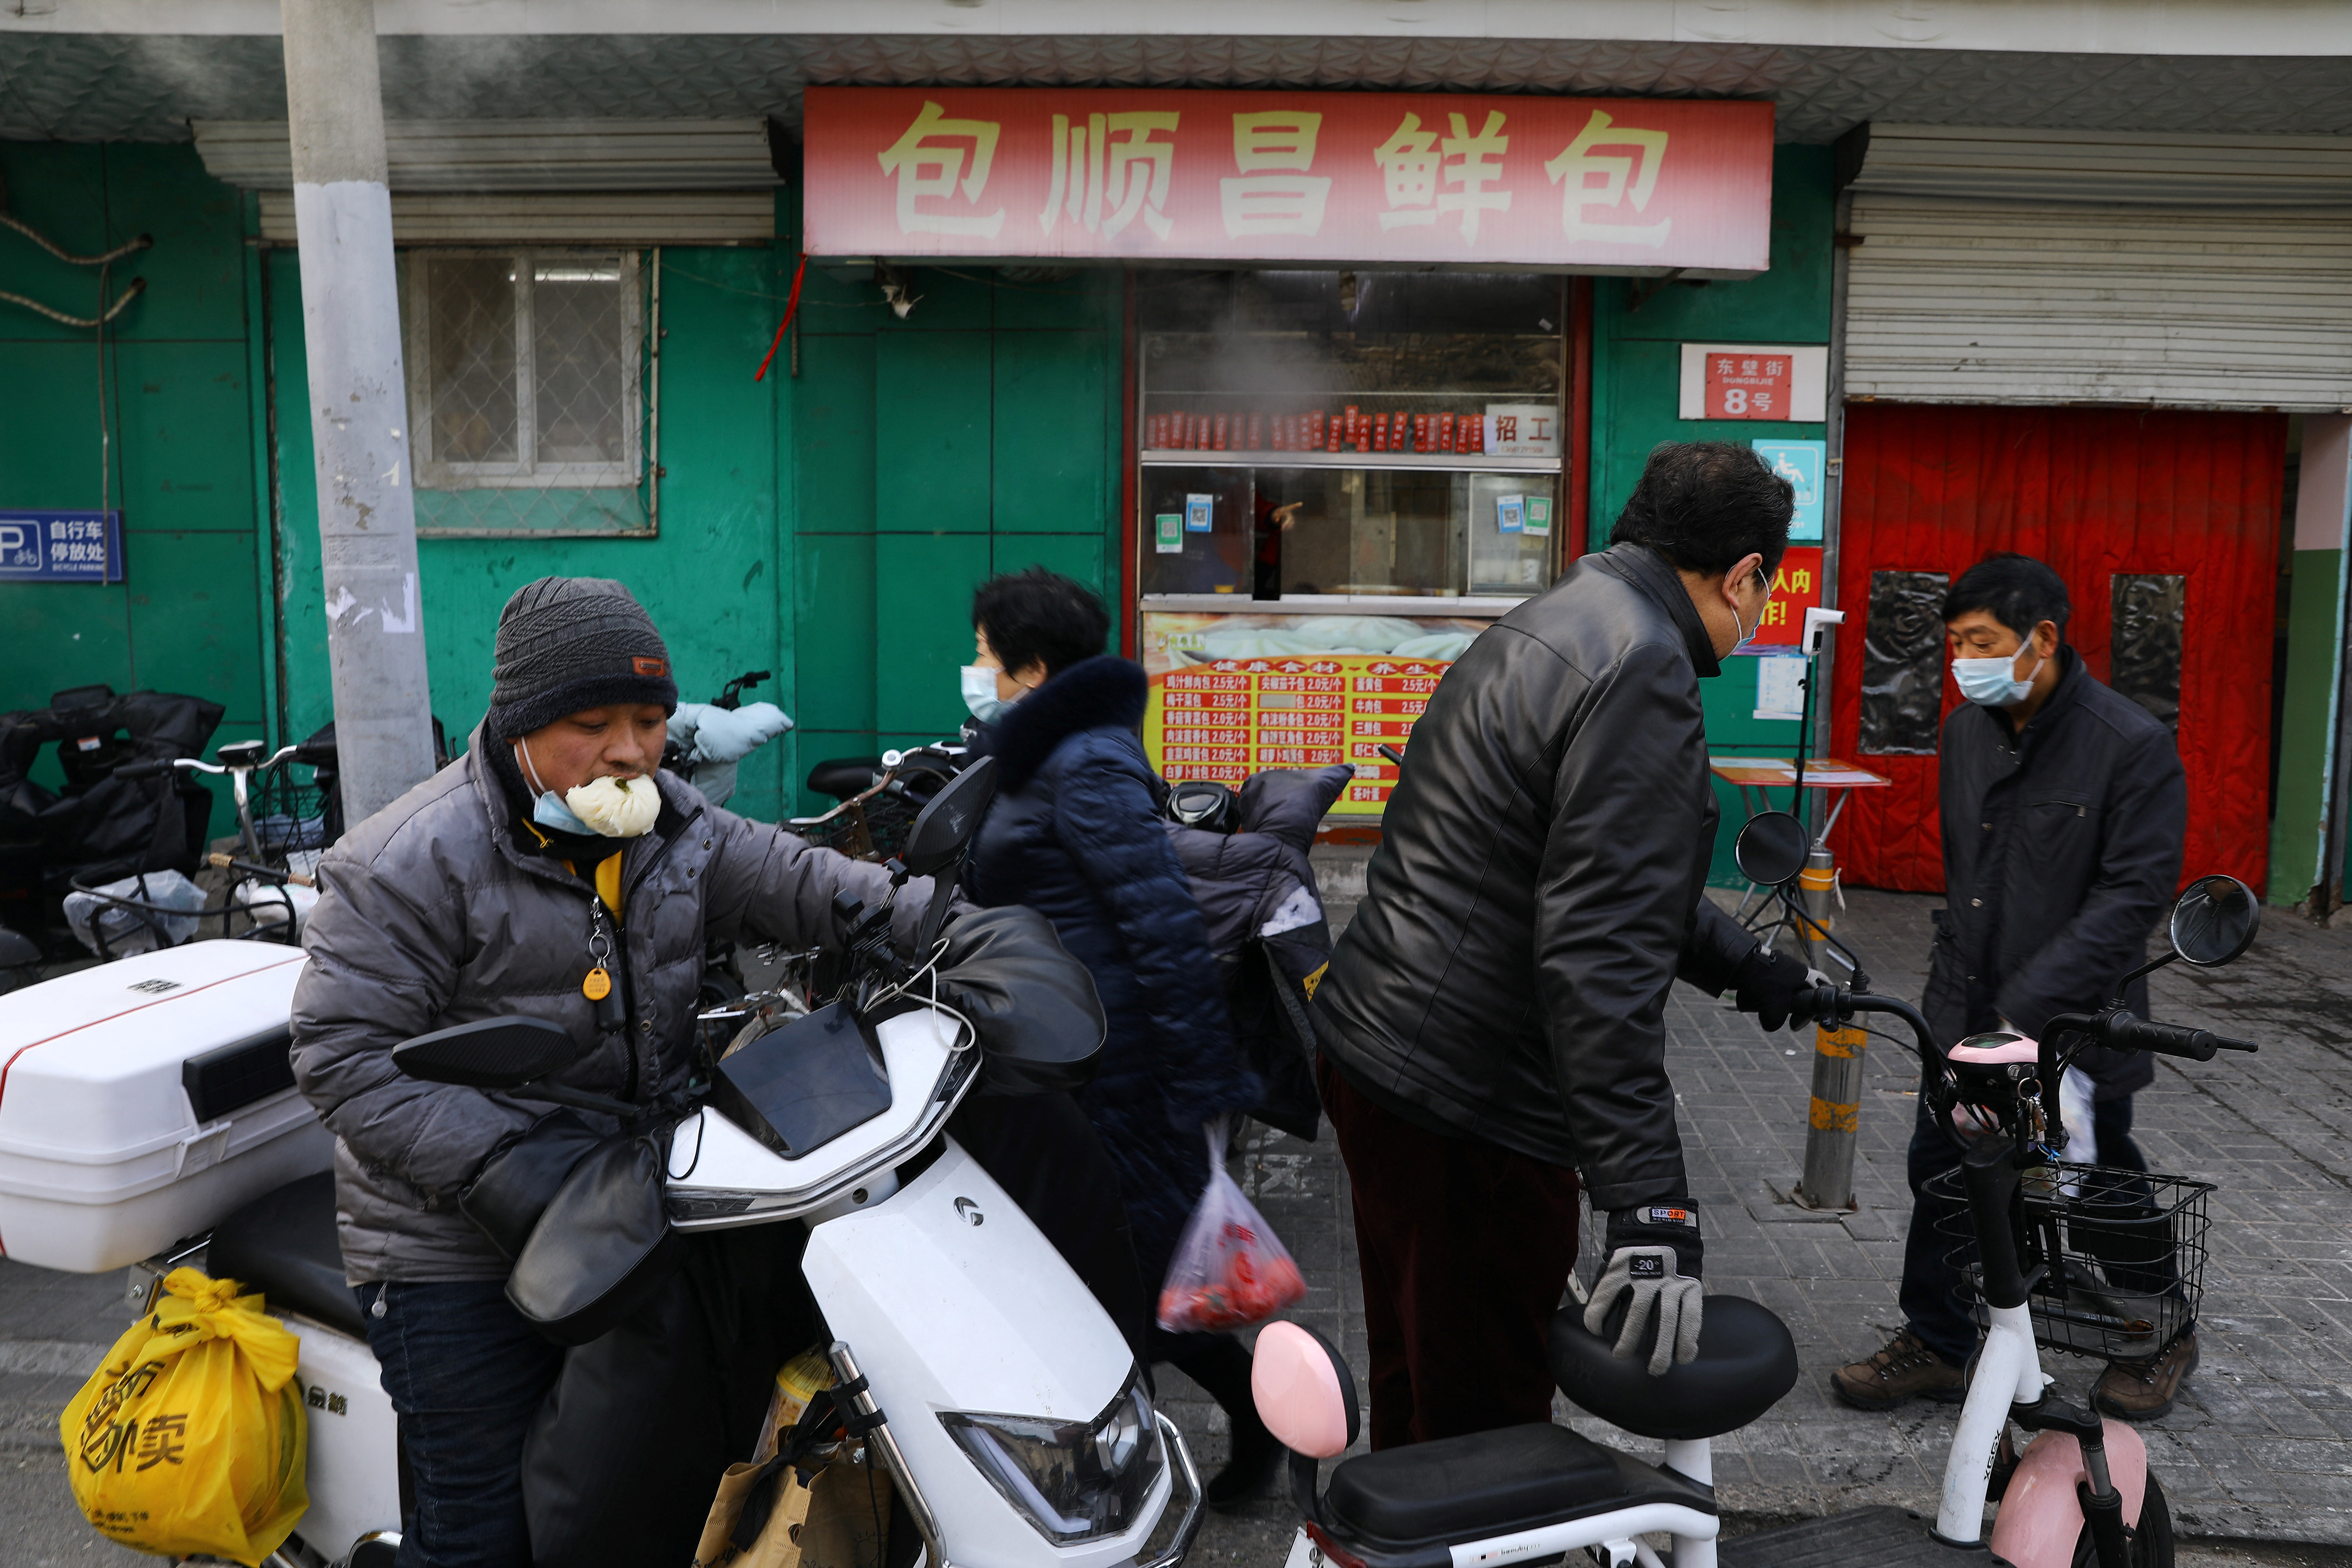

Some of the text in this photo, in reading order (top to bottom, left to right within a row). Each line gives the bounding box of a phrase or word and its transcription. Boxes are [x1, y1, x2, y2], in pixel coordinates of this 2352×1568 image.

[877, 101, 1675, 248] 包顺昌鲜包
[1722, 377, 1774, 386] DONGBIJIE
[1724, 388, 1773, 415] 8号
[1496, 415, 1552, 442] 招工
[50, 520, 103, 540] 自行车
[51, 542, 105, 562] 停放处
[1211, 659, 1337, 674] 健康食材
[1213, 677, 1247, 689] 2.5元/个
[1308, 678, 1341, 690] 2.0元/个
[1213, 695, 1246, 708] 2.5元/个
[1308, 696, 1341, 709] 2.0元/个
[1356, 700, 1381, 713] 牛肉包
[1213, 713, 1246, 725] 2.0元/个
[1307, 714, 1340, 727] 2.0元/个
[1355, 722, 1381, 735] 三鲜包
[1213, 731, 1245, 743] 2.0元/个
[1307, 732, 1340, 745] 2.0元/个
[1212, 749, 1245, 761] 2.0元/个
[1312, 750, 1339, 763] 2.0元/个
[1167, 765, 1208, 779] 白萝卜丝包
[1212, 767, 1245, 779] 2.0元/个
[1354, 787, 1379, 800] 茶叶蛋
[1653, 1209, 1684, 1218] SPORT
